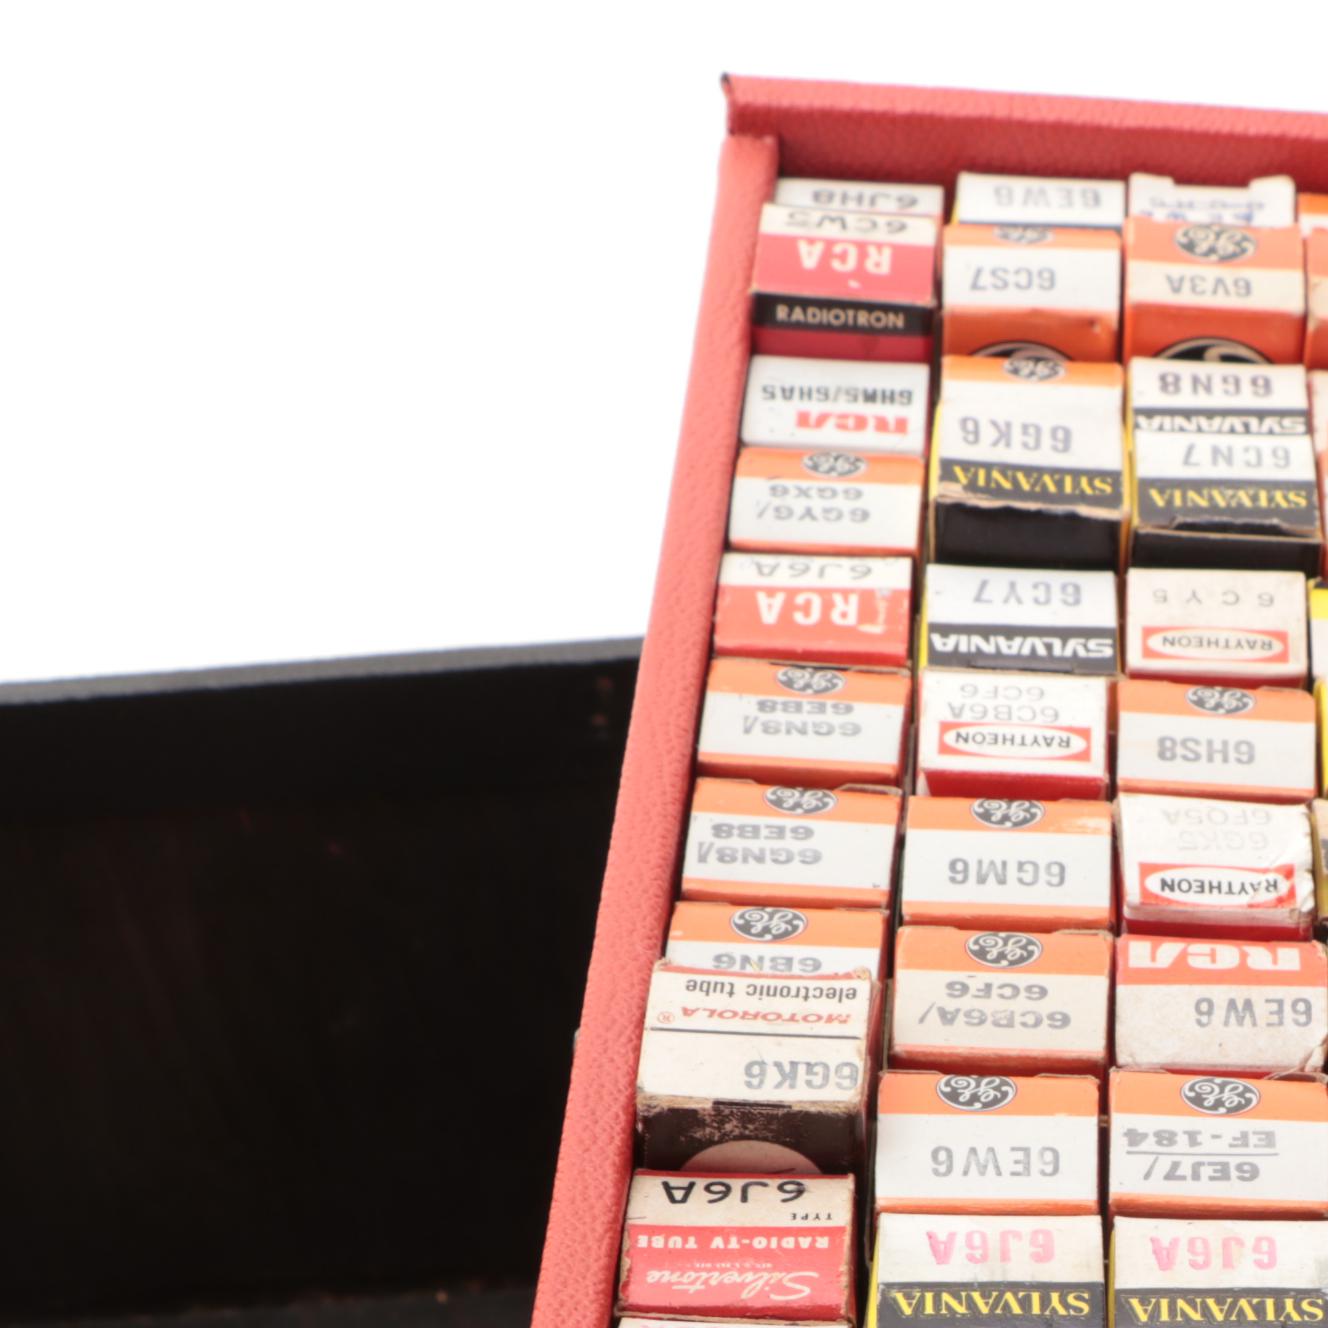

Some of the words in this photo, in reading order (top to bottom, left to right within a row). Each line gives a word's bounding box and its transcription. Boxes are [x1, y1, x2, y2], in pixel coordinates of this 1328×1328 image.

[796, 241, 892, 276] RCA
[970, 266, 1056, 292] 6CS7
[1165, 274, 1253, 299] 6V3A
[775, 304, 905, 329] RADIOTRON
[1158, 372, 1274, 399] 6GN8
[795, 411, 910, 436] RCA
[958, 416, 1073, 454] 6GK6
[1134, 414, 1308, 436] SYLVANIA
[1181, 442, 1291, 470] 6CN7
[952, 465, 1113, 498] SYLVANIA
[1148, 487, 1309, 511] SYLVANIA
[971, 578, 1083, 608] 6CY7
[755, 590, 860, 626] RCA
[929, 632, 1115, 660] SYLVANIA
[1160, 635, 1274, 653] RAYTHEON
[755, 699, 855, 715] 6EB8
[954, 730, 1072, 749] RAYTHEON
[1156, 736, 1256, 766] 6HS8
[710, 822, 815, 840] 6EB8
[947, 857, 1067, 888] 6GM6
[1159, 877, 1279, 897] RAYTHEON
[1127, 940, 1302, 973] RCA
[684, 979, 735, 998] tube
[745, 982, 858, 1004] electronic
[944, 980, 1050, 1001] 6CF6
[917, 1002, 1072, 1030] 6CB6A/
[1193, 996, 1313, 1029] 6EW6
[743, 1060, 861, 1091] 6GK6
[1121, 1127, 1277, 1149] EF-184
[929, 1146, 1062, 1178] 6EW6
[1142, 1156, 1261, 1183] 6EJ7/
[660, 1179, 806, 1205] 6J6A
[789, 1211, 833, 1221] TYPE
[635, 1234, 698, 1248] TUBE
[706, 1234, 830, 1249] RADIO-TV
[924, 1226, 1056, 1266] 6J6A
[1148, 1235, 1280, 1273] 6J6A
[645, 1267, 819, 1301] Silvertone
[889, 1289, 1091, 1317] SYLVANIA
